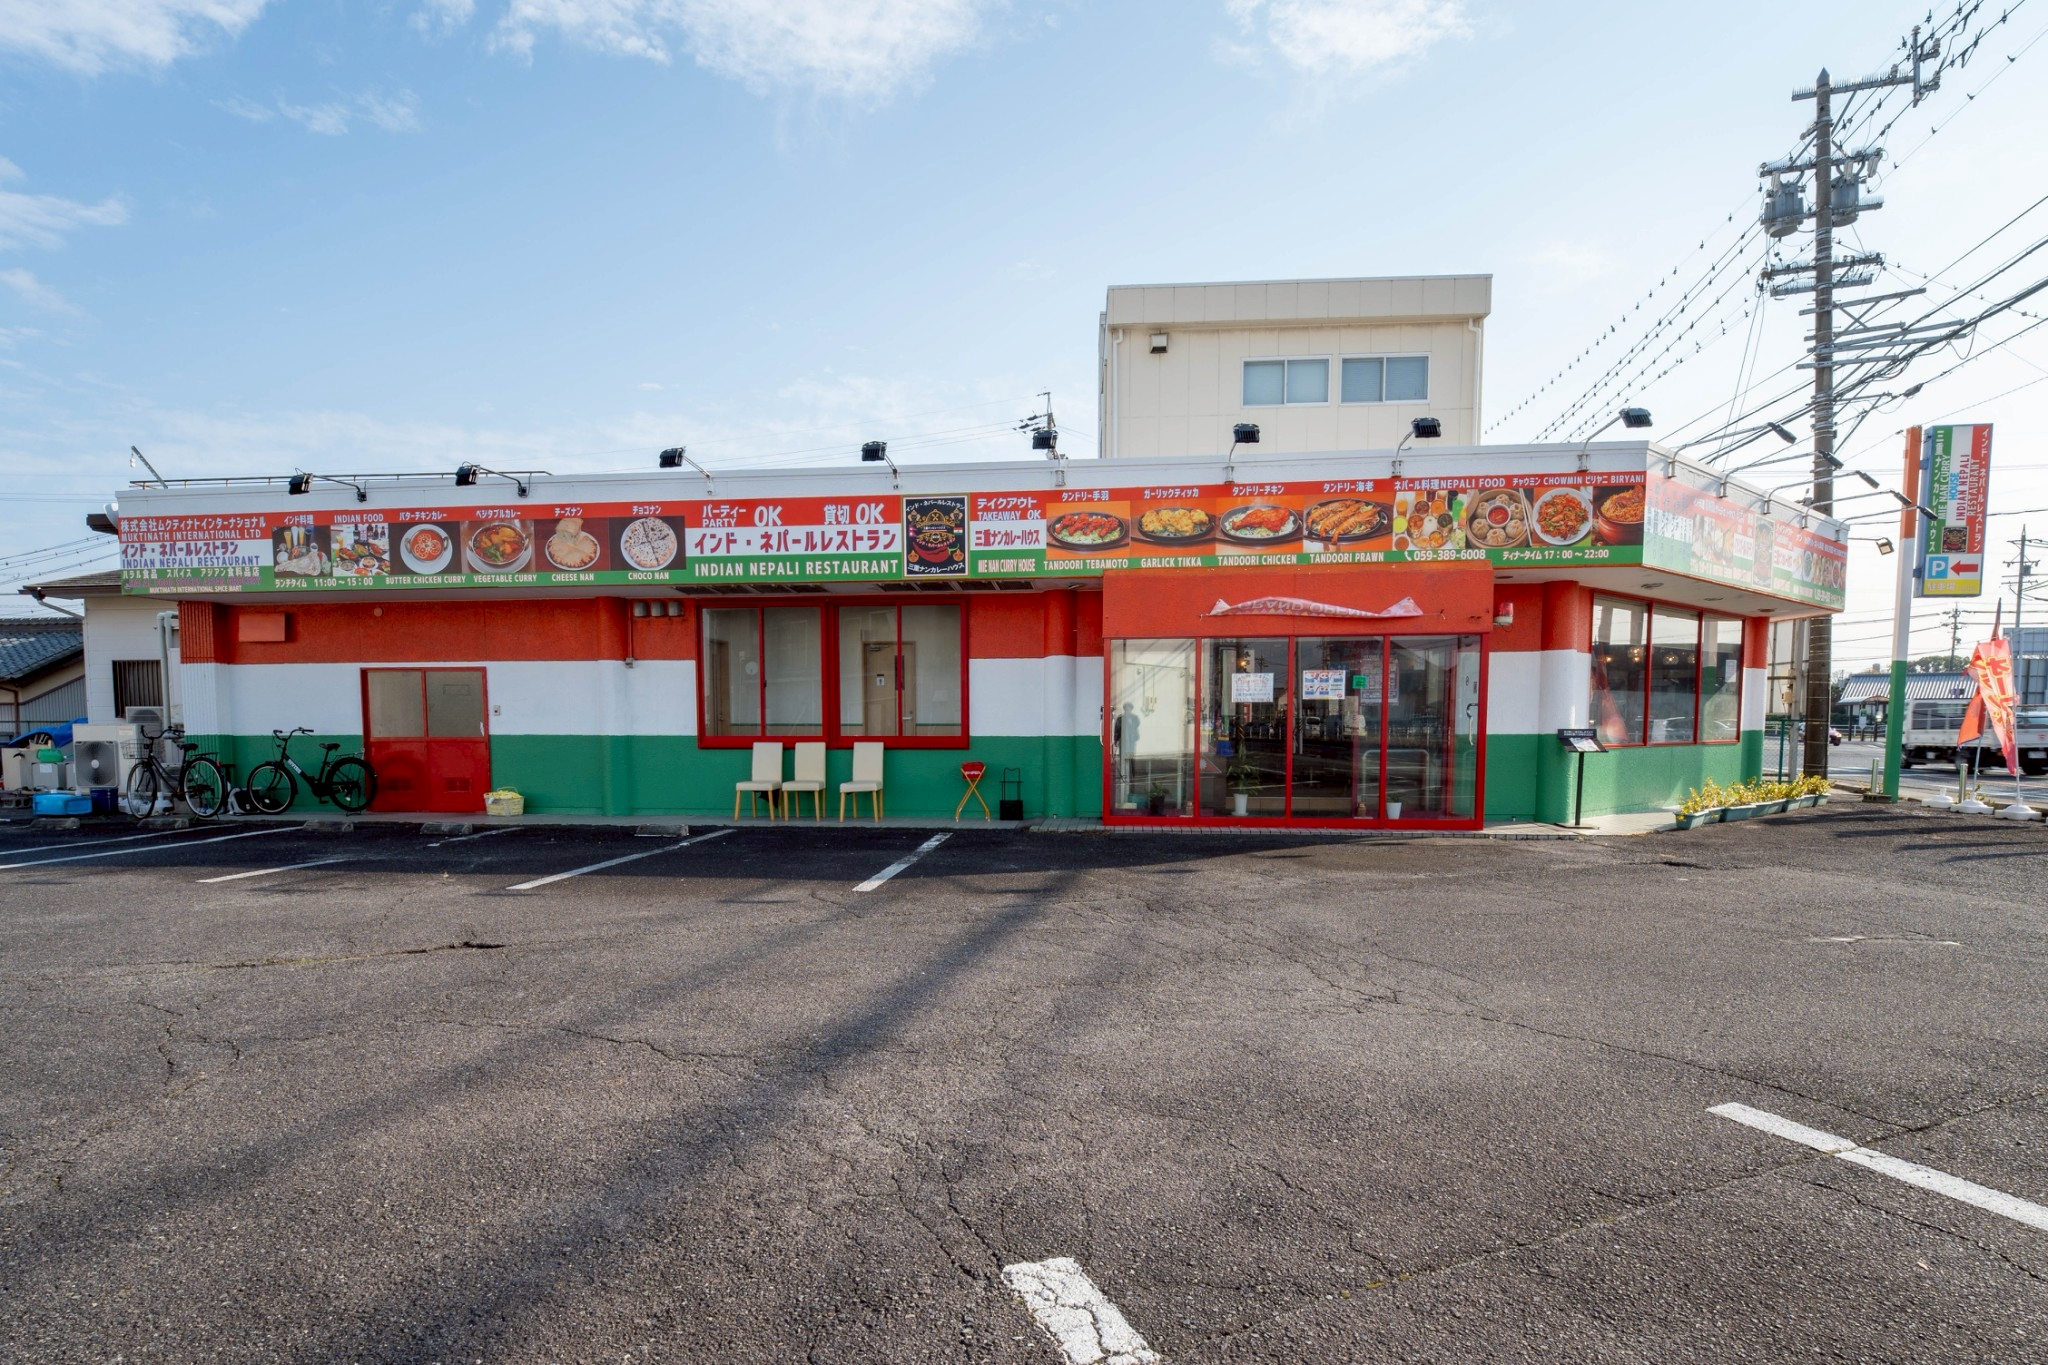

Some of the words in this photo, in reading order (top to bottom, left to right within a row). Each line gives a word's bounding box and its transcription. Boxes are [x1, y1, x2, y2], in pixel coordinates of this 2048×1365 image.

[1940, 455, 1951, 483] CURRY
[1958, 454, 1970, 486] NEPALI
[1479, 478, 1506, 487] FOOD
[1543, 475, 1582, 485] CHOWMIN
[1610, 474, 1644, 483] BIRYANI
[1232, 485, 1285, 496] タンドリーチキン
[1323, 481, 1374, 492] タンドリー海老
[1948, 472, 1959, 500] HOUSE
[1967, 459, 1980, 516] RESTAURANT
[1062, 490, 1109, 502] タンドリー手羽
[1939, 485, 1948, 503] NAN
[977, 497, 1037, 509] テイクアウト
[1955, 489, 1967, 521] INDIAN
[632, 505, 662, 514] チョコナン
[702, 504, 747, 518] パーティー
[823, 504, 850, 525] 貸切
[855, 503, 885, 524] OK
[977, 511, 1021, 521] TAKEAWAY
[1027, 509, 1042, 520] OK
[1937, 504, 1947, 520] MIE
[283, 515, 315, 525] インド料理
[334, 515, 361, 523] INDIAN
[363, 513, 384, 522] FOOD
[753, 505, 783, 527] OK
[702, 518, 737, 527] PARTY
[121, 531, 169, 542] MUKTINATH
[173, 530, 241, 540] INTERNATIONAL
[244, 529, 261, 538] LTD
[1218, 556, 1259, 566] TANDOORI
[1261, 554, 1297, 565] CHICKEN
[1309, 552, 1352, 563] TANDOORI
[1354, 552, 1384, 562] PRAWN
[1413, 549, 1486, 561] 059-389-6008
[122, 559, 155, 569] INDIAN
[160, 557, 193, 568] NEPALI
[197, 556, 260, 566] RESTAURANT
[1044, 559, 1083, 571] TANDOORI
[1086, 558, 1128, 569] TEBAMOTO
[1141, 557, 1175, 568] GARLICK
[1178, 556, 1201, 567] TIKKA
[1931, 560, 1946, 576] P
[694, 563, 743, 577] INDIAN
[750, 561, 799, 576] NEPALI
[806, 560, 898, 574] RESTAURANT
[385, 576, 411, 584] BUTTER
[413, 575, 442, 584] CHICKEN
[444, 575, 466, 583] CURRY
[473, 574, 513, 583] VEGETABLE
[515, 574, 537, 582] CURRY
[551, 573, 577, 581] CHEESE
[580, 573, 594, 581] NAN
[628, 572, 652, 580] CHOCO
[655, 571, 670, 580] NAN
